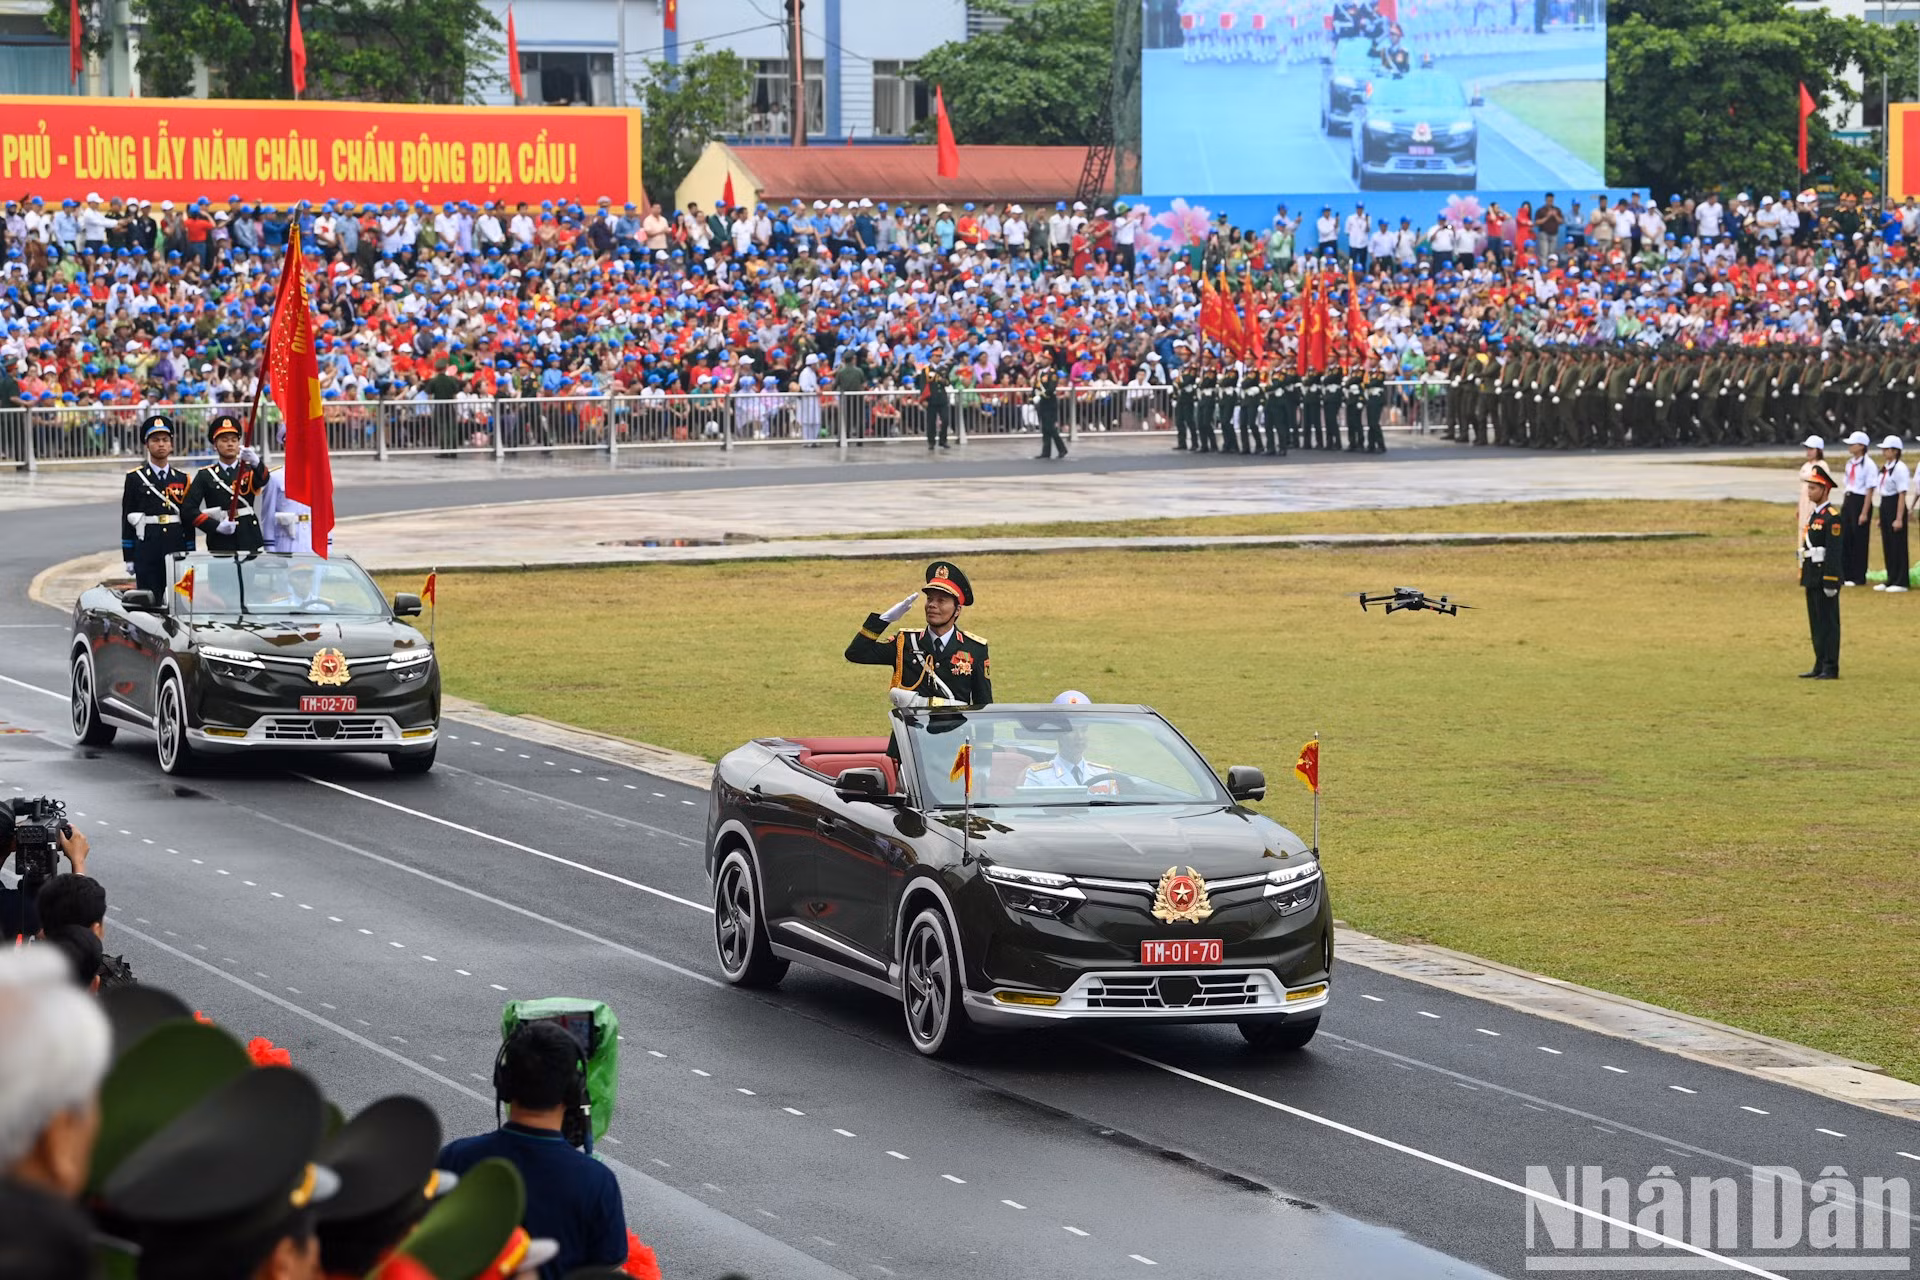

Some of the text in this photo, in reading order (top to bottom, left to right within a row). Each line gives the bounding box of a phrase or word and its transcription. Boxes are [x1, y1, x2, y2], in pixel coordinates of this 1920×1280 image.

[2, 119, 51, 179] PHỦ
[74, 125, 137, 180] LỪNG
[143, 119, 186, 180] LẪY
[193, 128, 249, 181] NĂM
[255, 129, 326, 187] CHÂU,
[331, 125, 396, 183] CHẤN
[401, 132, 466, 193] ĐỘNG
[472, 142, 513, 193] ĐỊA
[1143, 943, 1220, 963] TM-01-70
